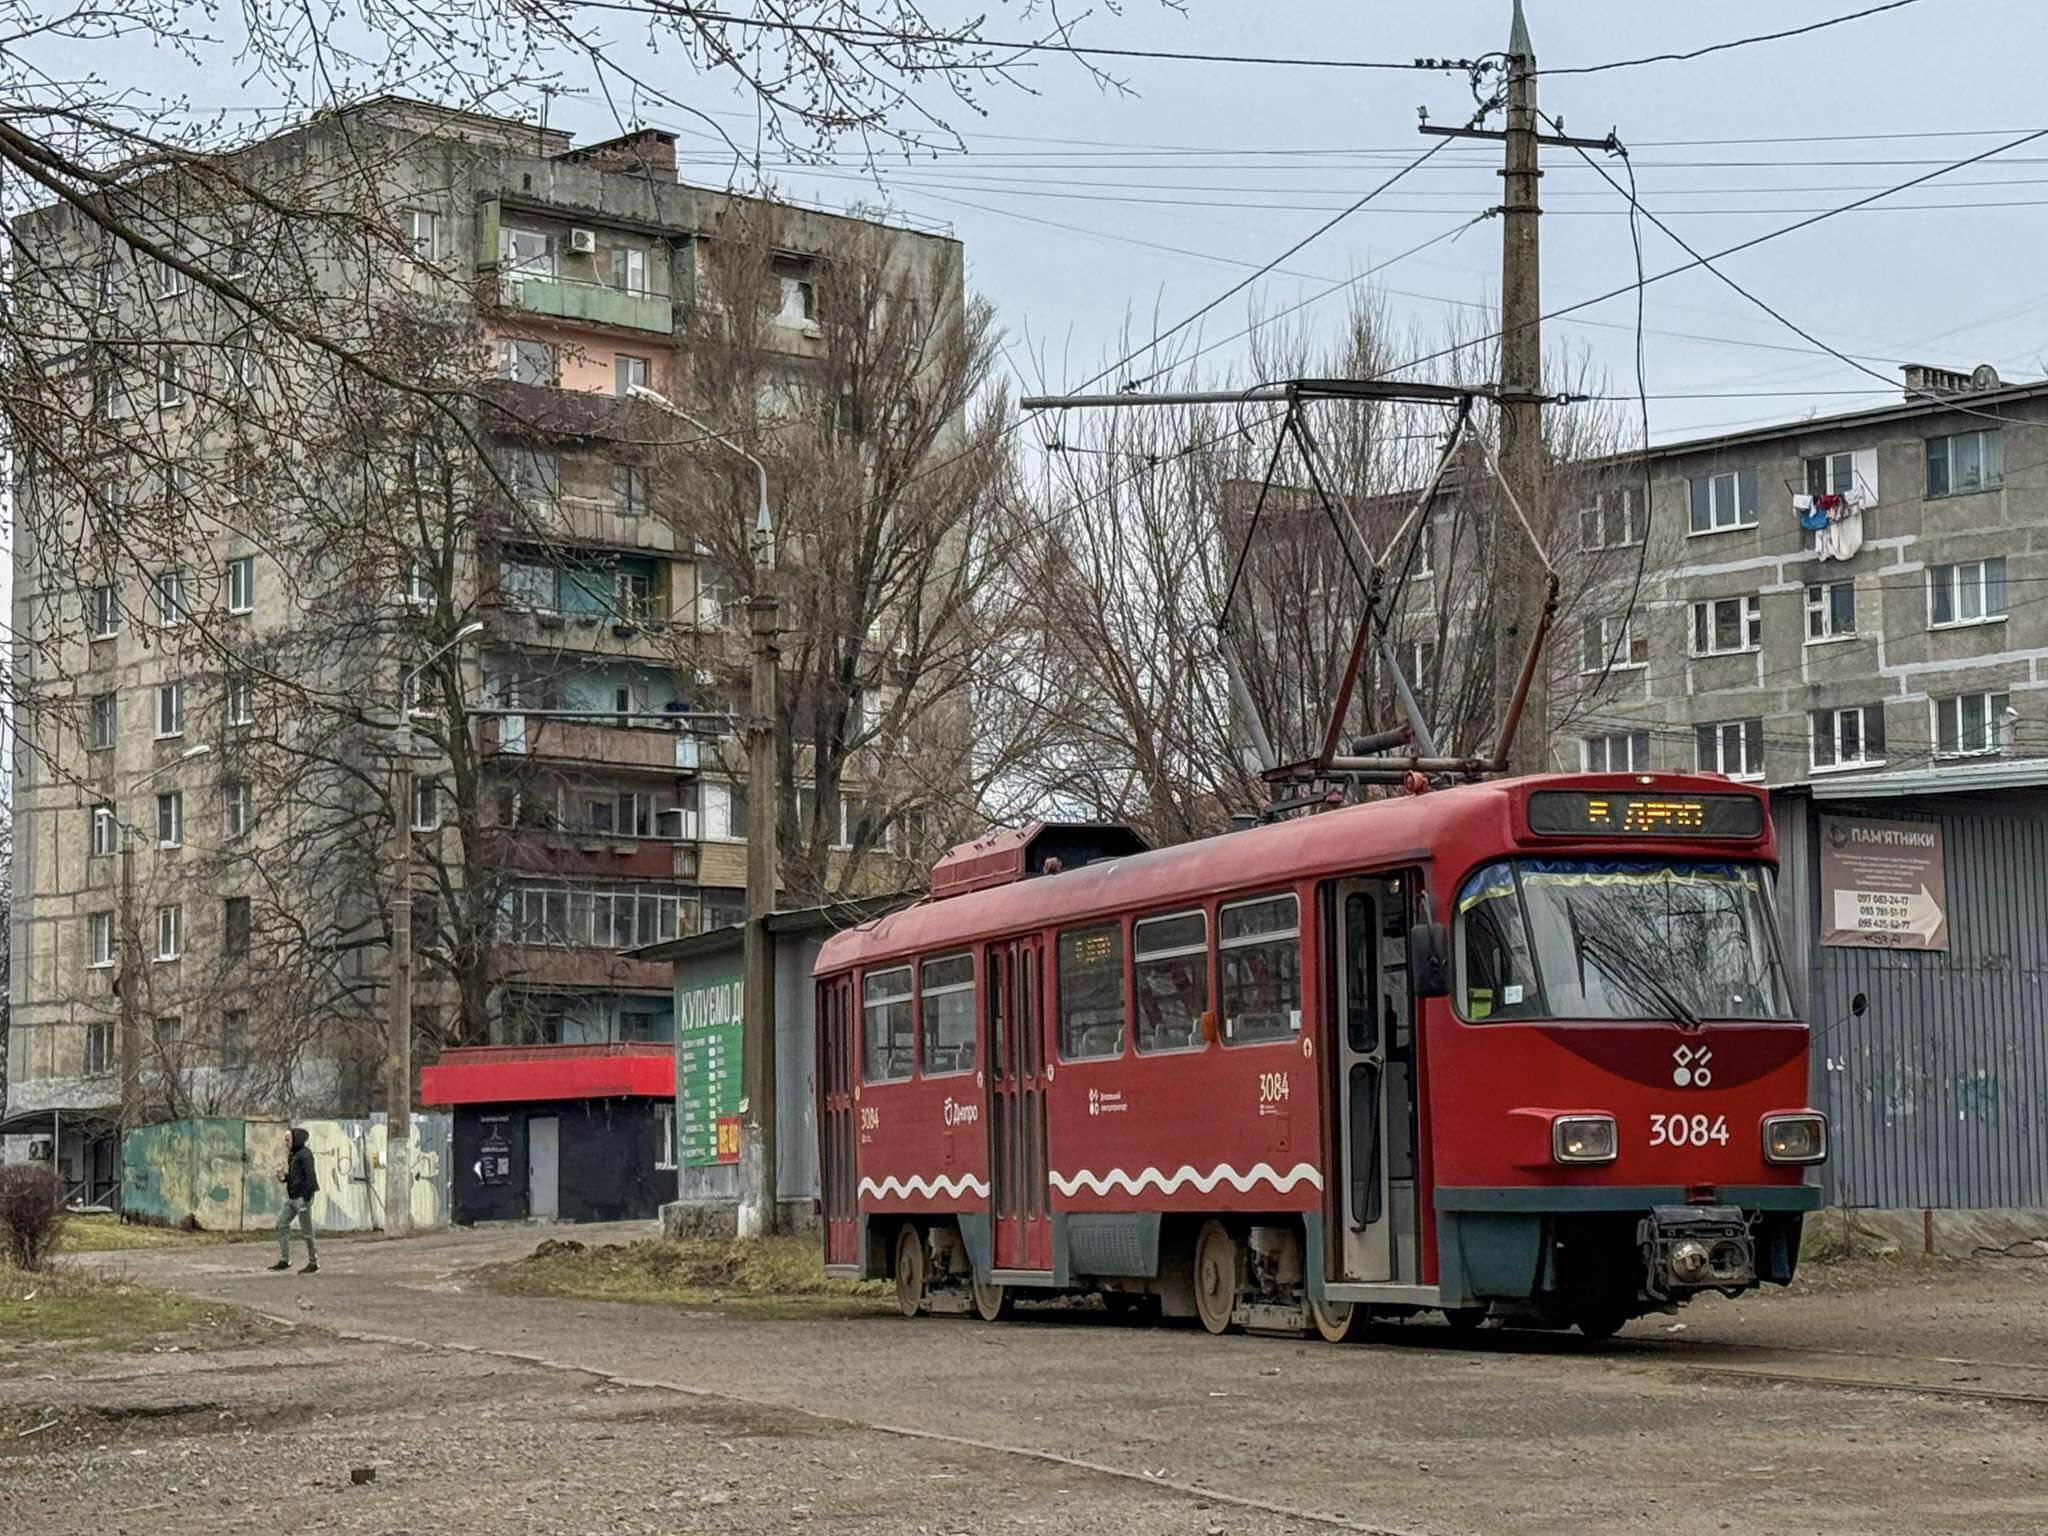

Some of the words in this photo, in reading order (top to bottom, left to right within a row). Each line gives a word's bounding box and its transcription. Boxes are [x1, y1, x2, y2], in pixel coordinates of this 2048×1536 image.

[1851, 828, 1935, 848] ПАМ'ЯТНИКИ
[681, 984, 731, 1031] КУПУЄМО
[1260, 1072, 1290, 1102] 3084
[861, 1107, 880, 1130] 3084
[1649, 1113, 1729, 1146] 3084
